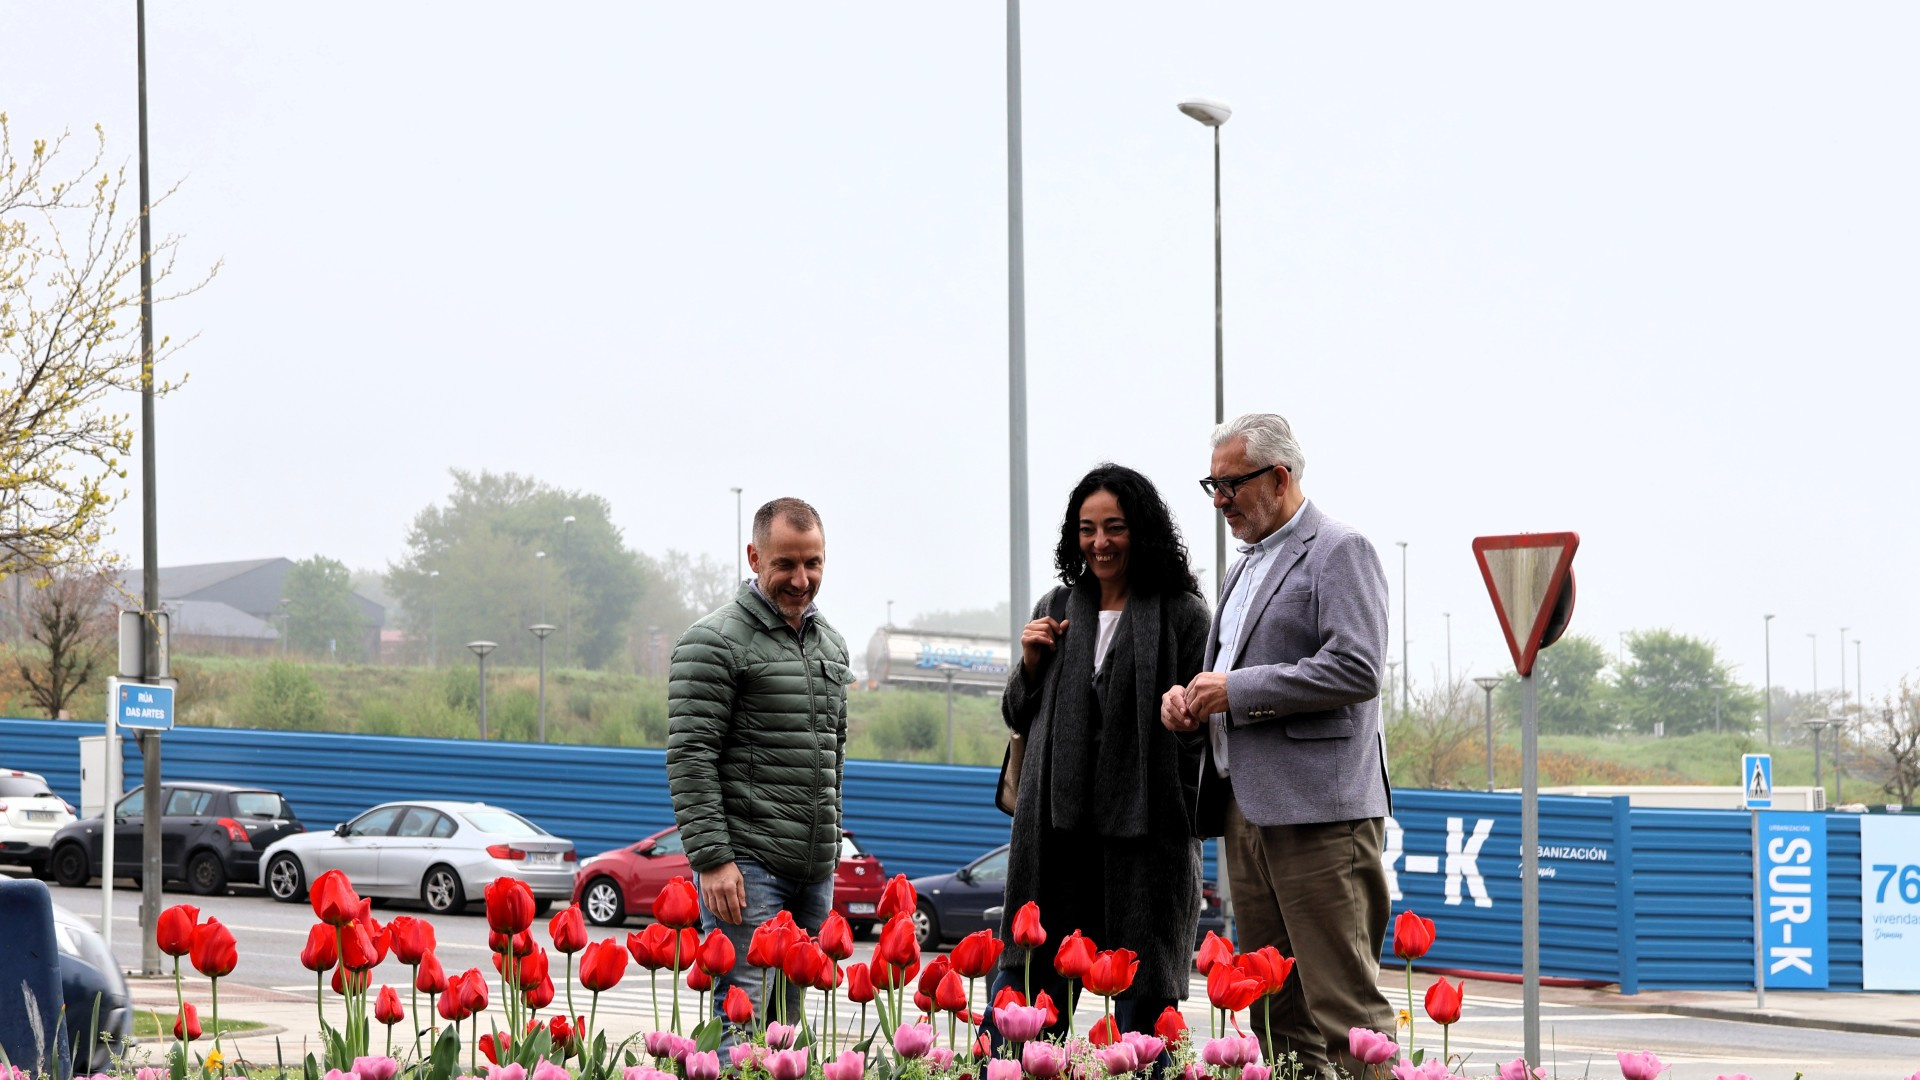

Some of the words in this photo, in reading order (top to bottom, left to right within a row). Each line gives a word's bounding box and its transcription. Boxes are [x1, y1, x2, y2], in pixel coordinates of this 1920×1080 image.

[138, 691, 154, 703] RÚA
[125, 706, 141, 718] DAS
[141, 708, 165, 720] ARTES
[1519, 845, 1607, 861] BANIZACIÓN
[1768, 837, 1813, 976] SUR-K
[1872, 912, 1920, 925] vivenda
